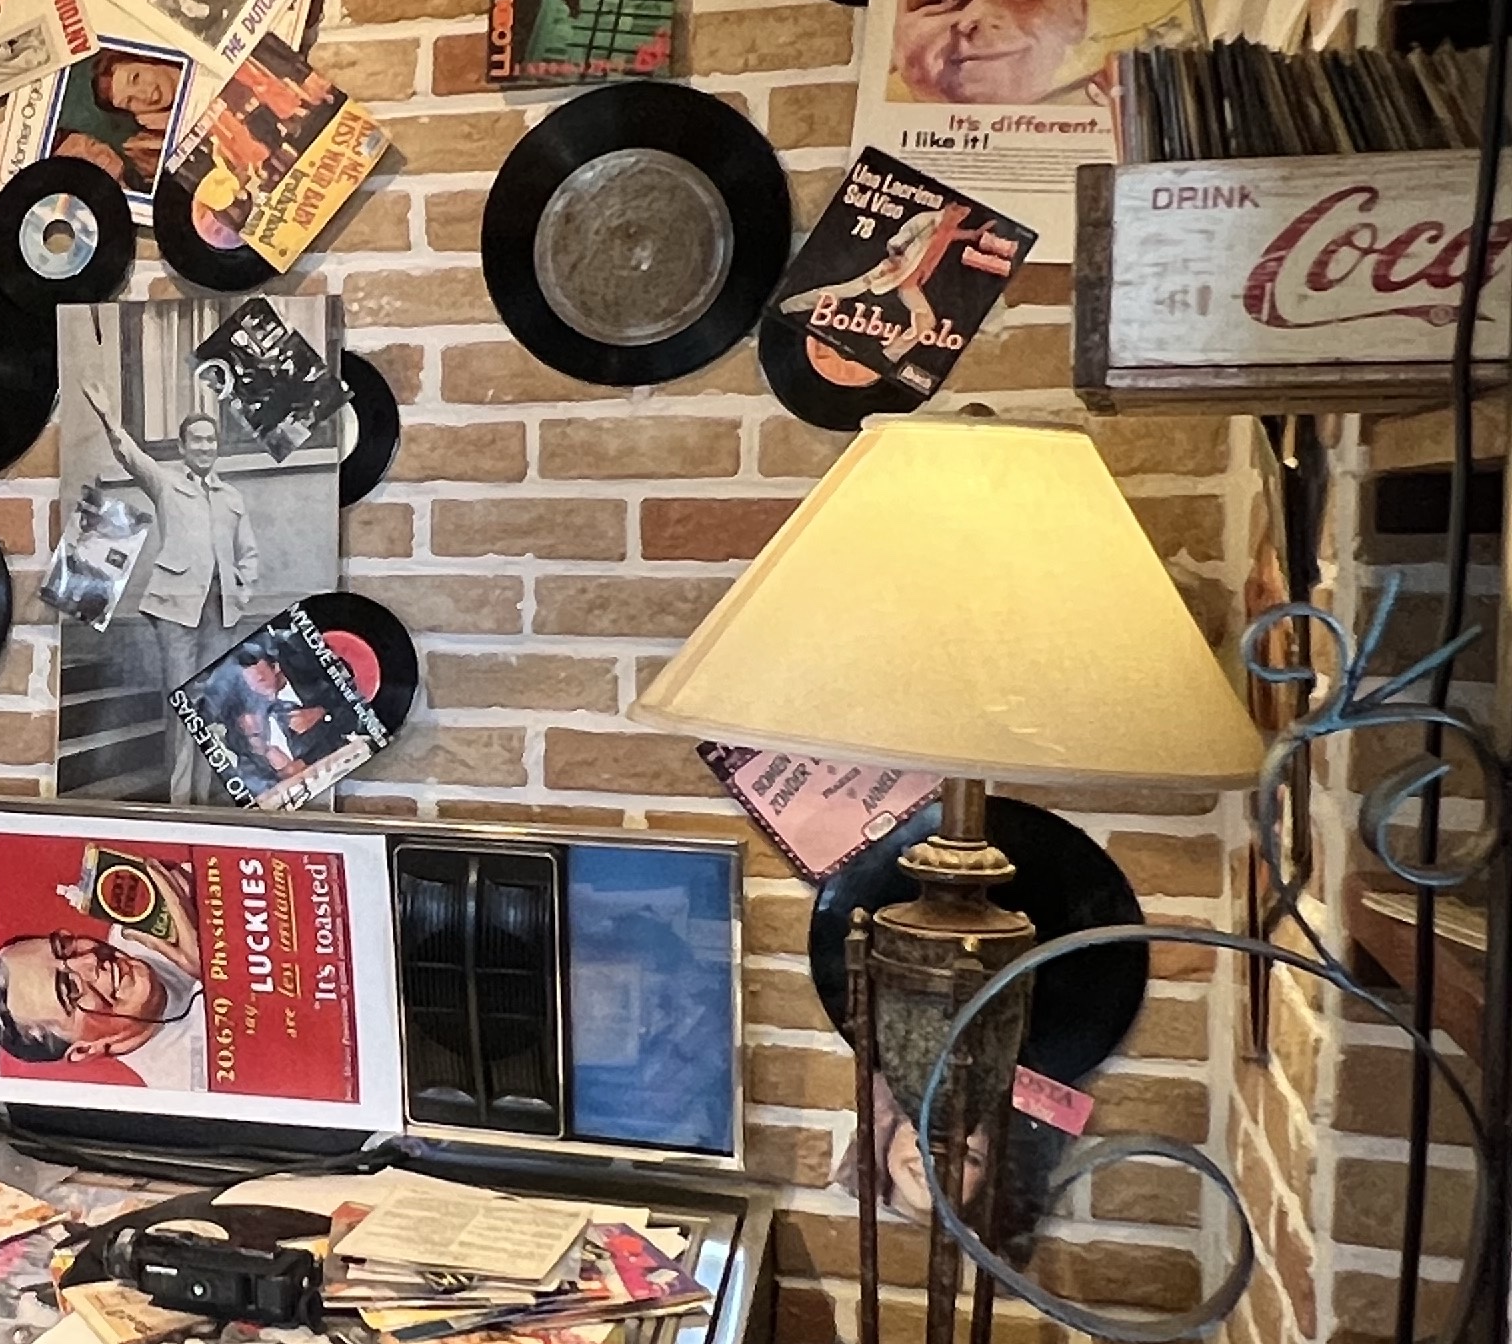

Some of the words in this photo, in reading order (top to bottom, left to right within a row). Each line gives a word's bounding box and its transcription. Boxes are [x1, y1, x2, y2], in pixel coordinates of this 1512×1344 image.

[220, 32, 245, 65] THE
[901, 131, 908, 148] I
[915, 131, 956, 149] like
[963, 133, 990, 150] it!
[949, 114, 981, 132] It's
[844, 184, 870, 210] Sul
[871, 192, 905, 220] Viso
[882, 173, 944, 209] Lacrima
[1152, 186, 1260, 211] DRINK
[851, 215, 877, 240] 78
[1243, 184, 1512, 329] Coca
[810, 291, 901, 346] Bobby
[289, 601, 312, 633] MY
[303, 626, 335, 668] LOVE
[169, 689, 231, 774] IGLESIAS
[206, 855, 230, 981] Physicians
[277, 962, 302, 999] less
[244, 1004, 259, 1037] say
[285, 1007, 298, 1039] are
[215, 996, 237, 1085] 20,679
[1021, 1073, 1073, 1110] OSTA
